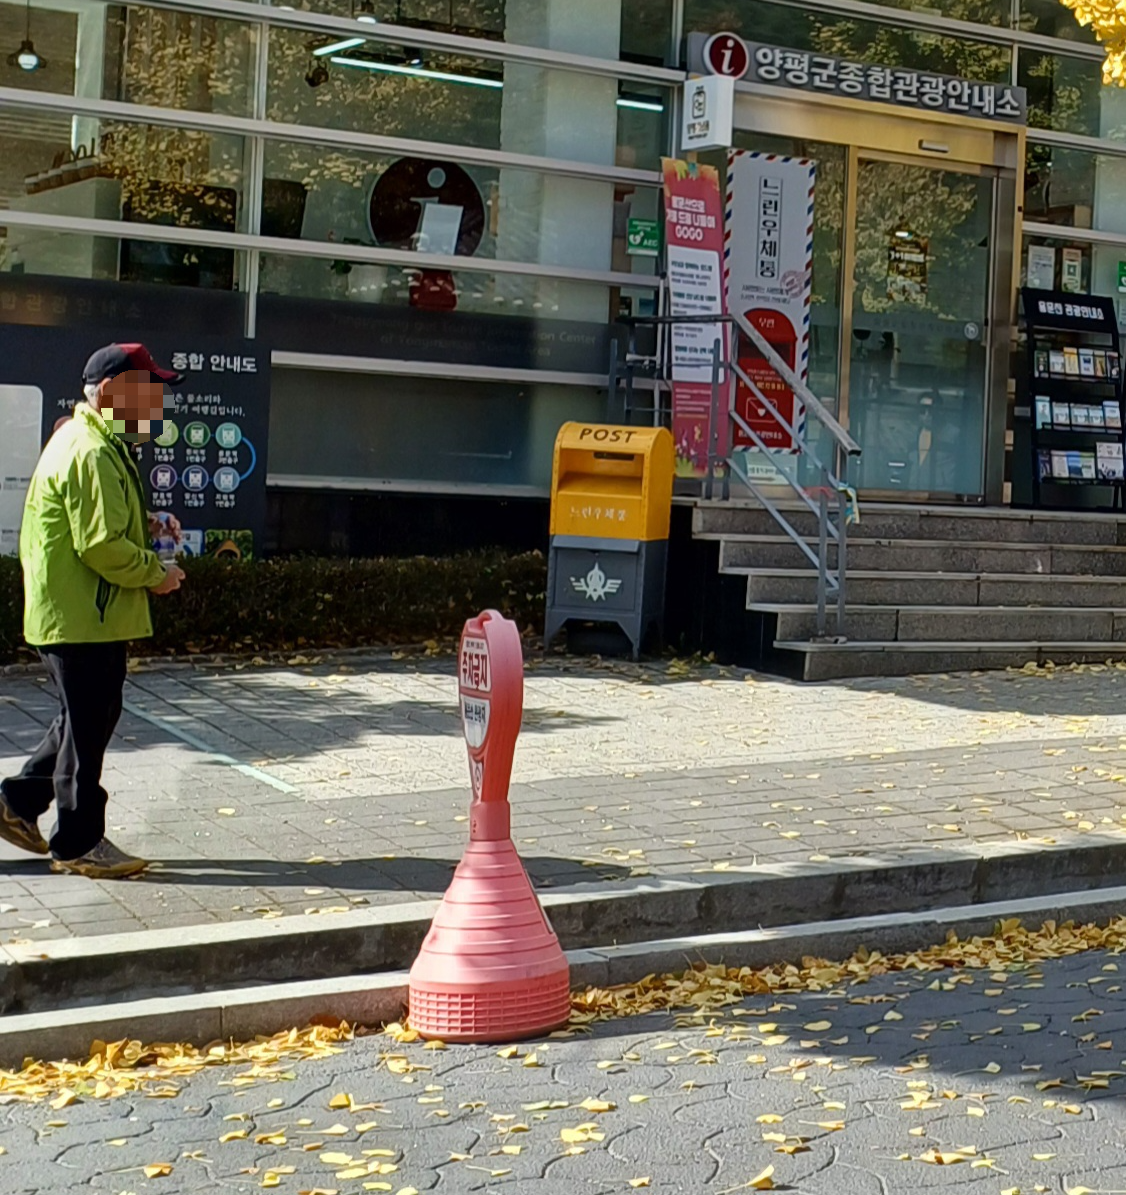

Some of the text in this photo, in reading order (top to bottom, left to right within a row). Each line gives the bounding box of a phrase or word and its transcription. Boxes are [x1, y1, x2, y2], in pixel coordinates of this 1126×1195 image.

[755, 46, 1021, 117] 양평군종합관광안내소
[675, 225, 704, 241] GOGO
[759, 178, 780, 278] 느린우체통
[171, 352, 257, 373] 종합 안내도
[579, 427, 638, 444] POST
[462, 651, 489, 690] 주차금지
